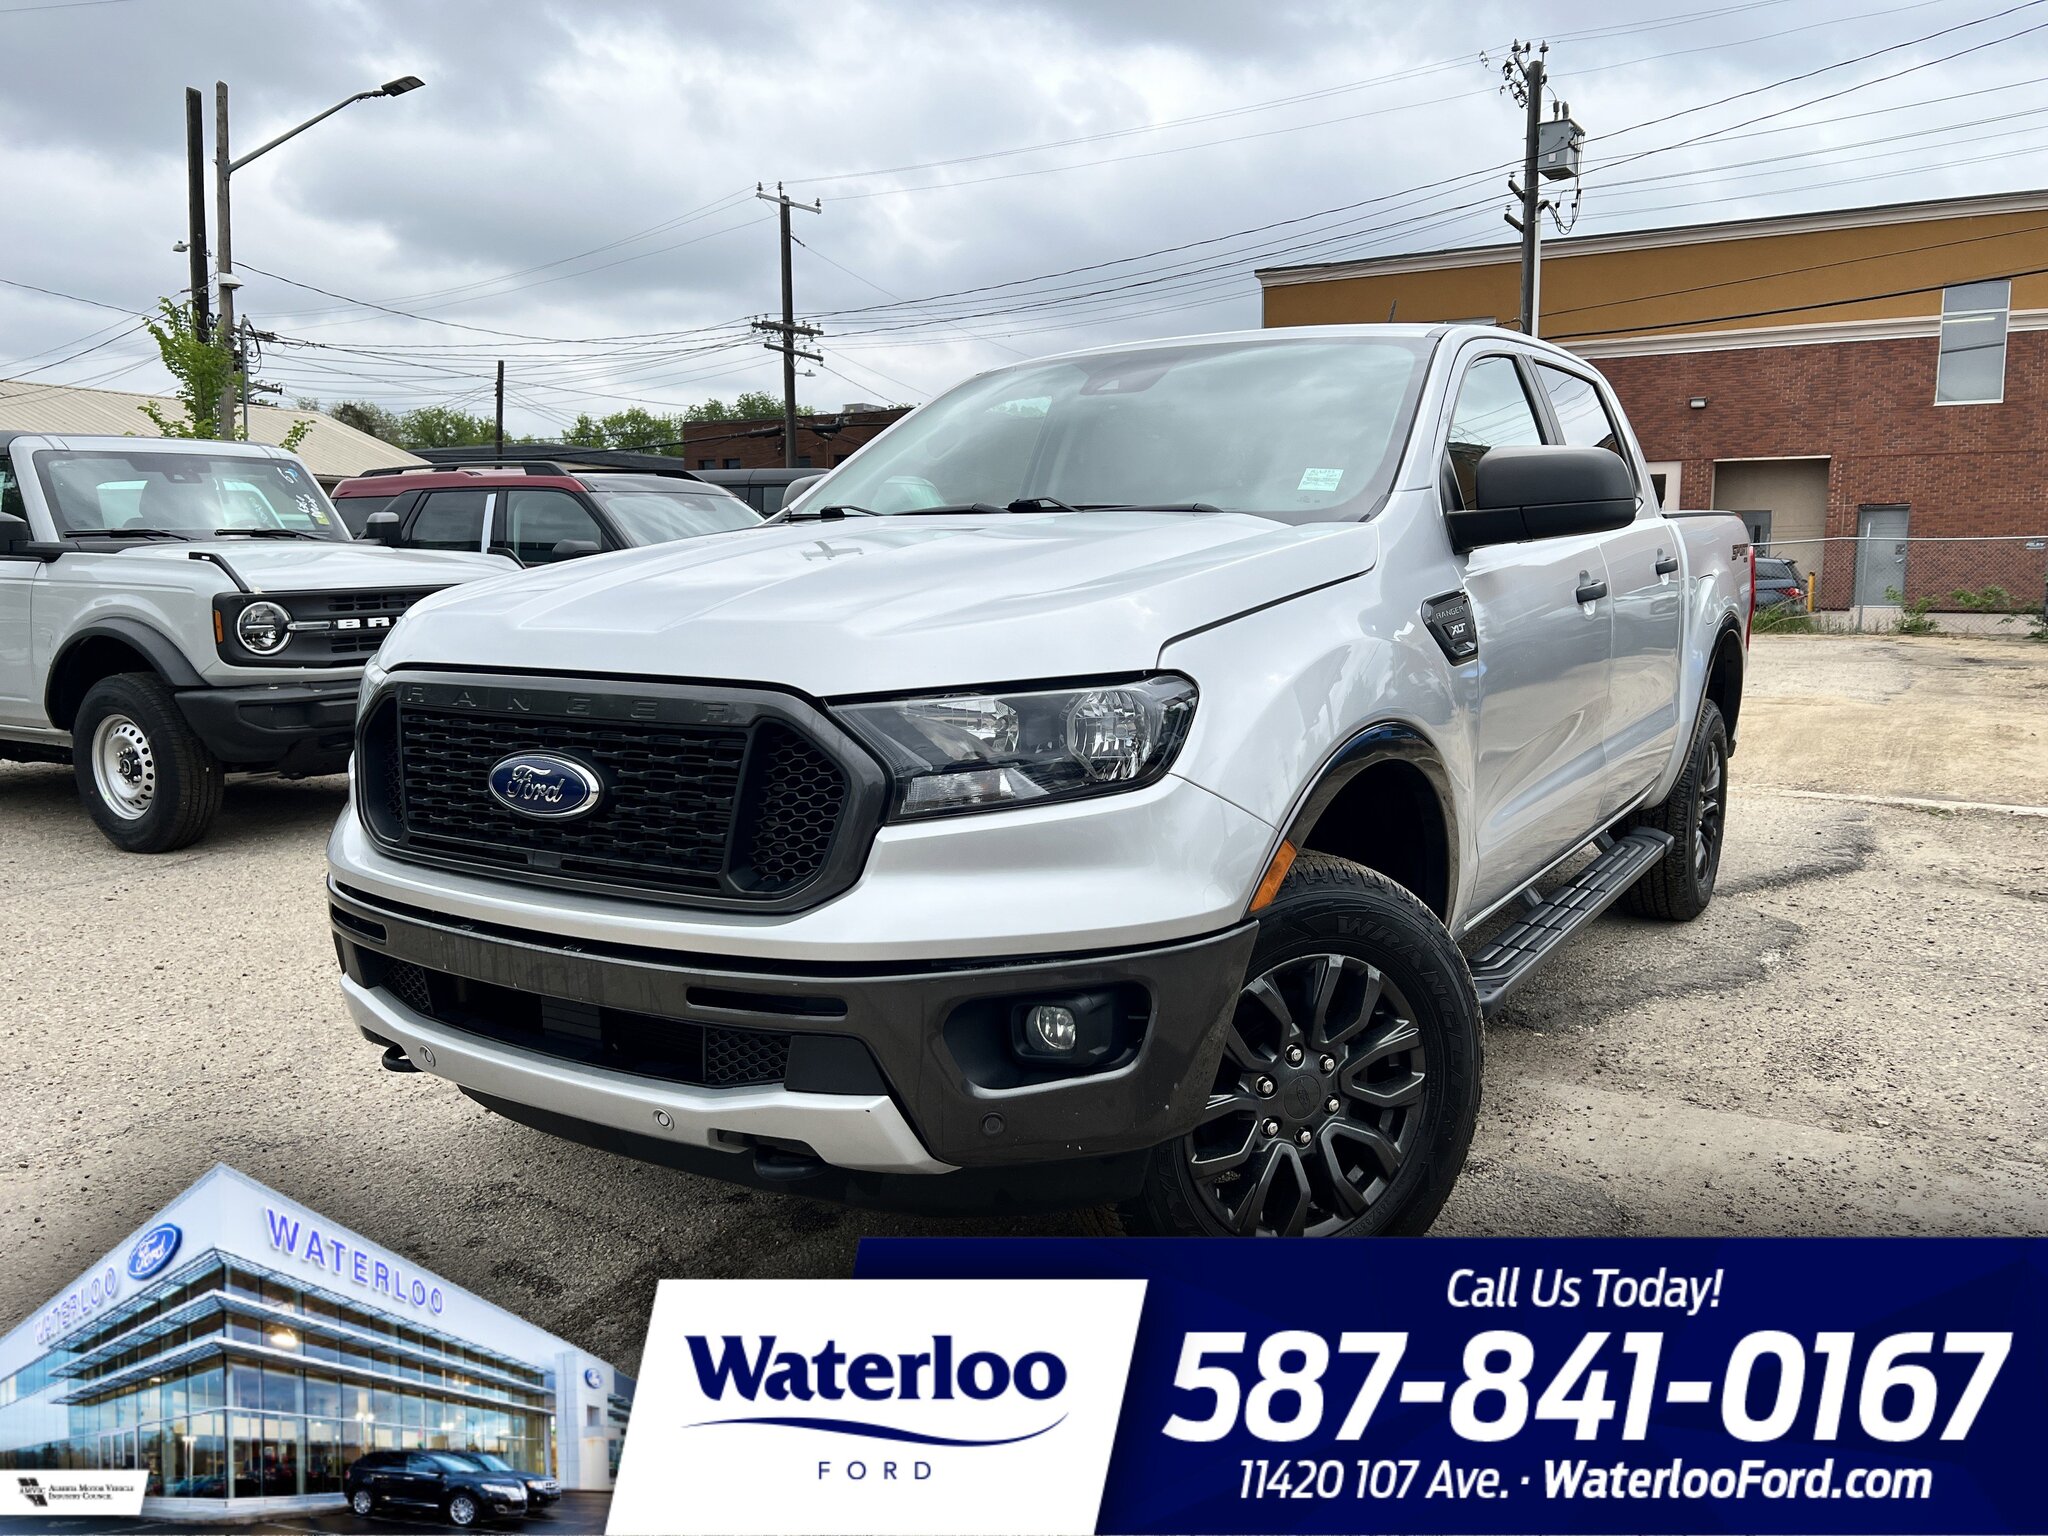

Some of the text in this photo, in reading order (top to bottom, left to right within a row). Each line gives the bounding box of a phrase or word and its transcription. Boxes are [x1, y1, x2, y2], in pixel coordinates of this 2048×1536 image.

[1435, 605, 1465, 620] RANGER
[337, 616, 403, 630] BR
[1450, 622, 1466, 636] XLT
[406, 684, 732, 723] RANGER
[506, 764, 566, 803] Ford
